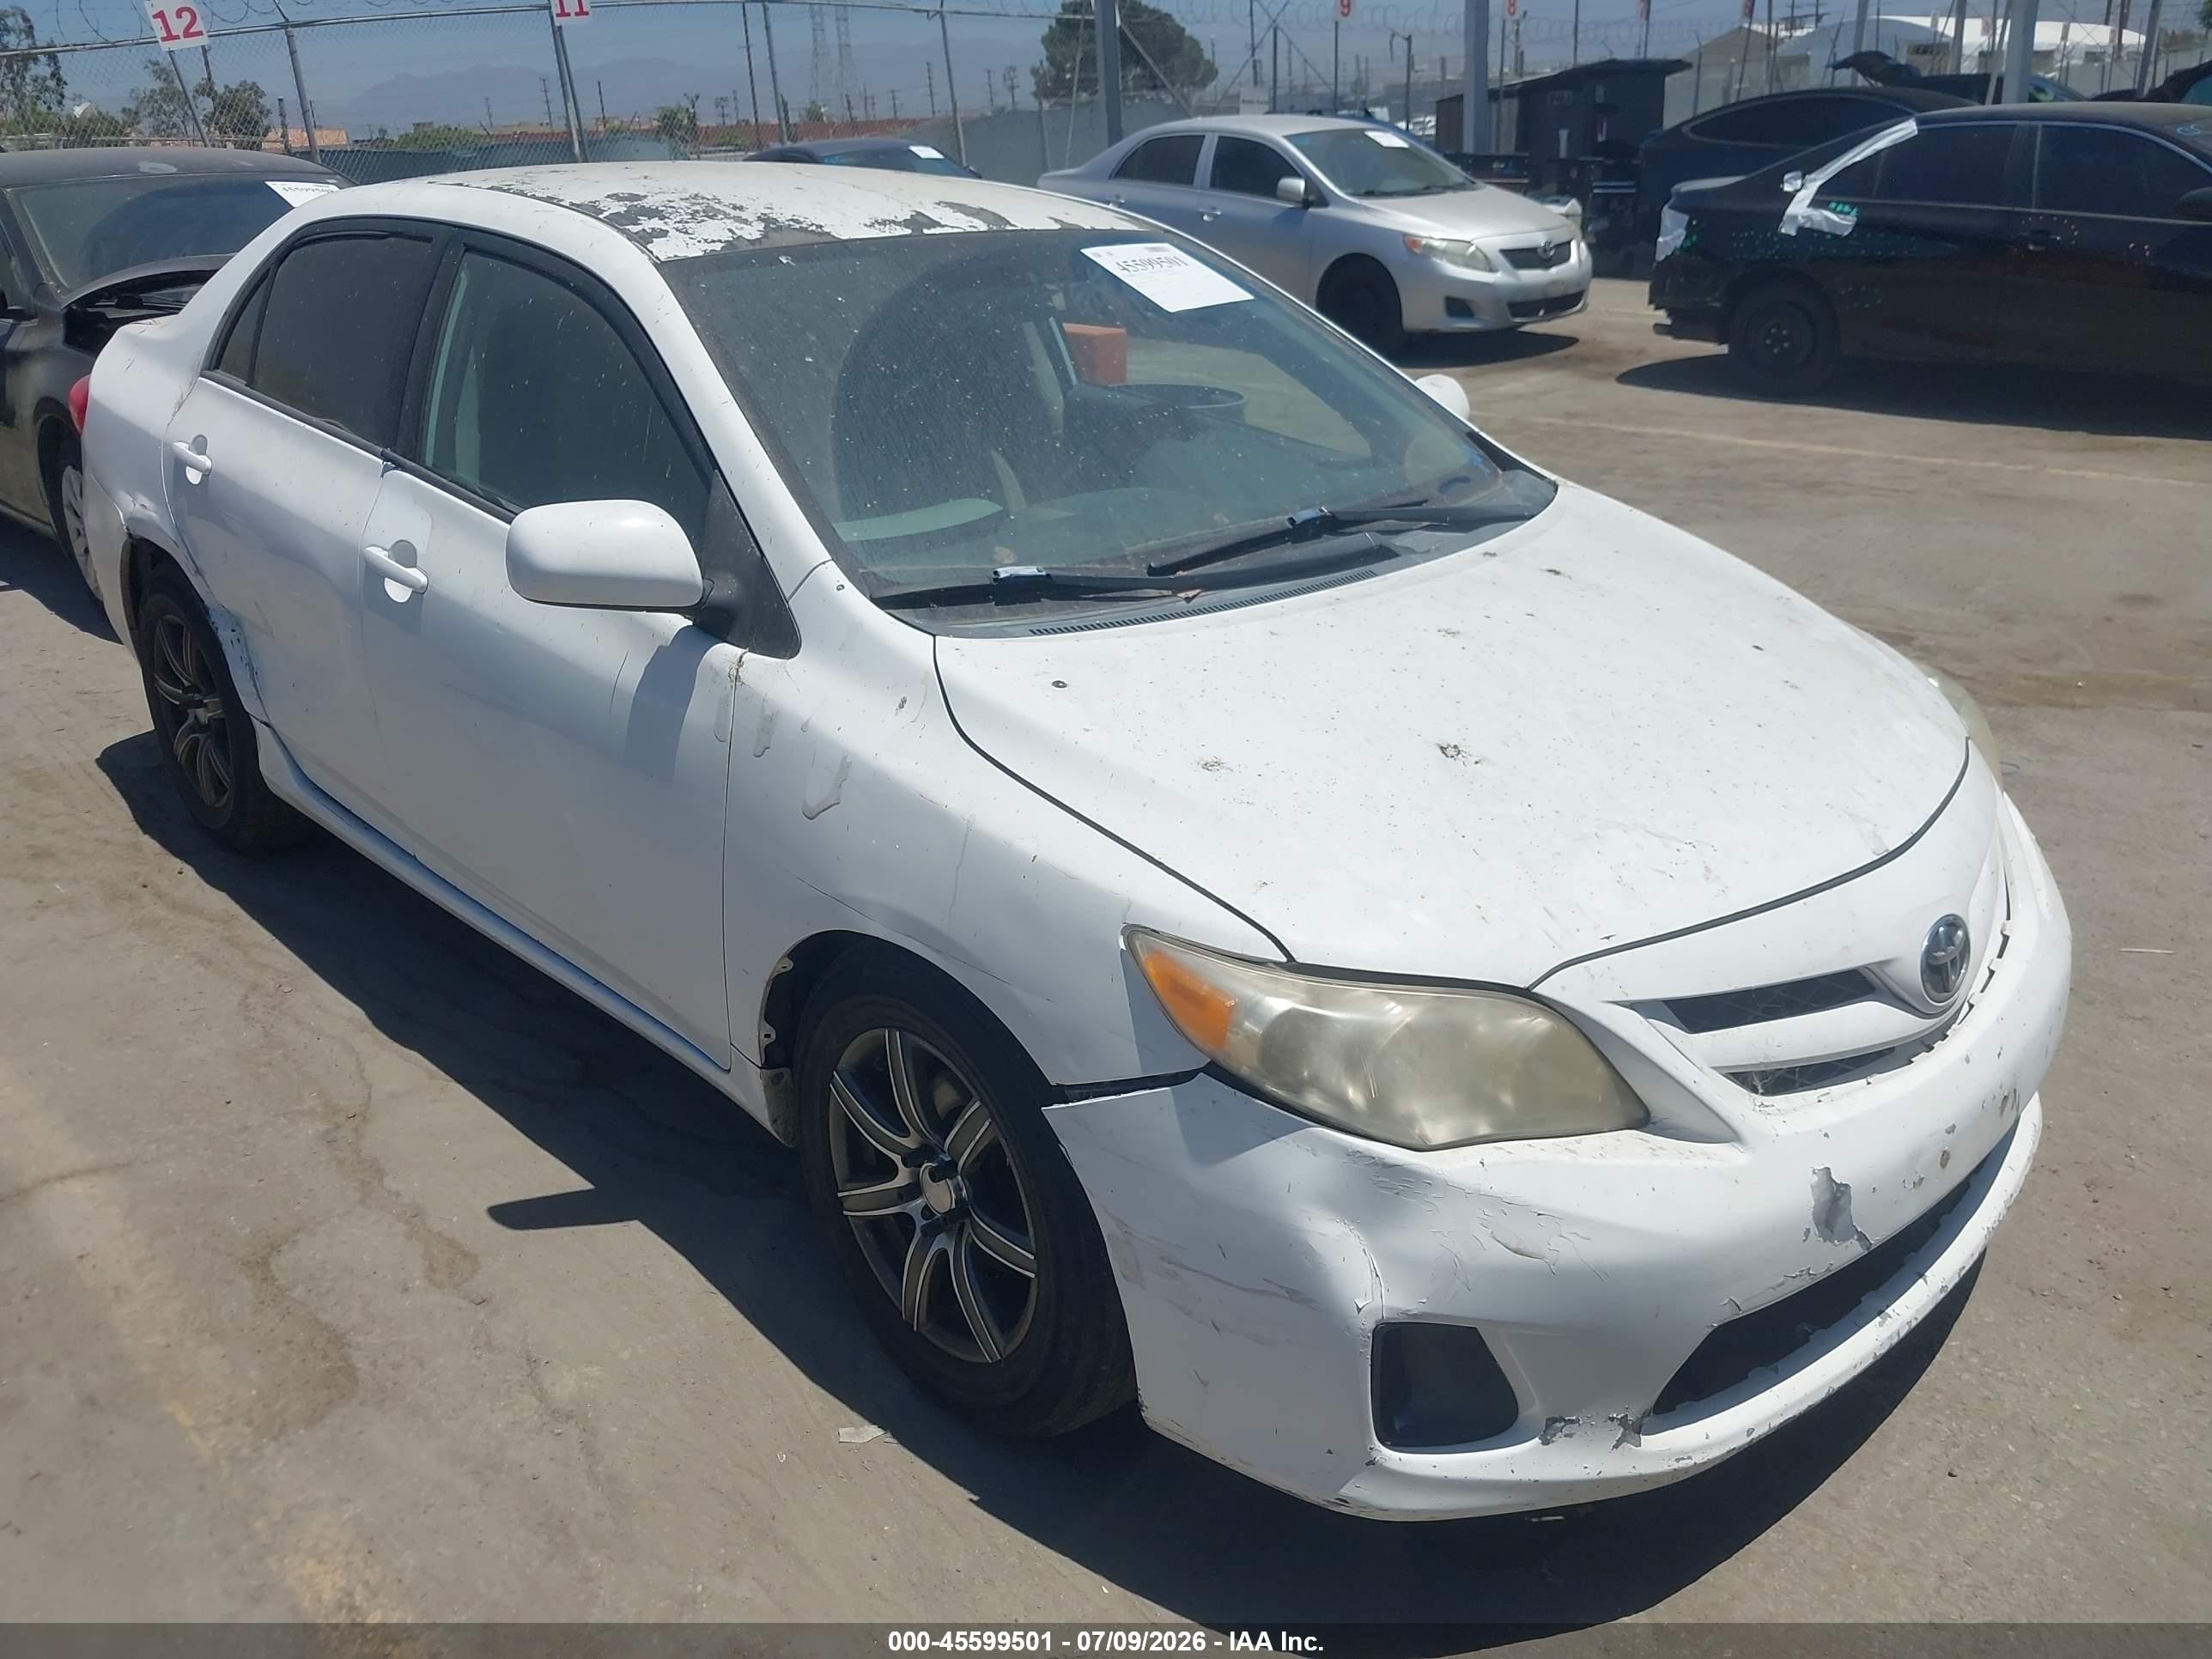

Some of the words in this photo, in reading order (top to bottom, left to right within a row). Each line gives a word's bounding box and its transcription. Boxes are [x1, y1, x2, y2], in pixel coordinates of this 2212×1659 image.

[556, 0, 589, 17] 11
[1340, 0, 1351, 17] 9
[152, 7, 204, 42] 12
[1115, 255, 1189, 274] 45599501
